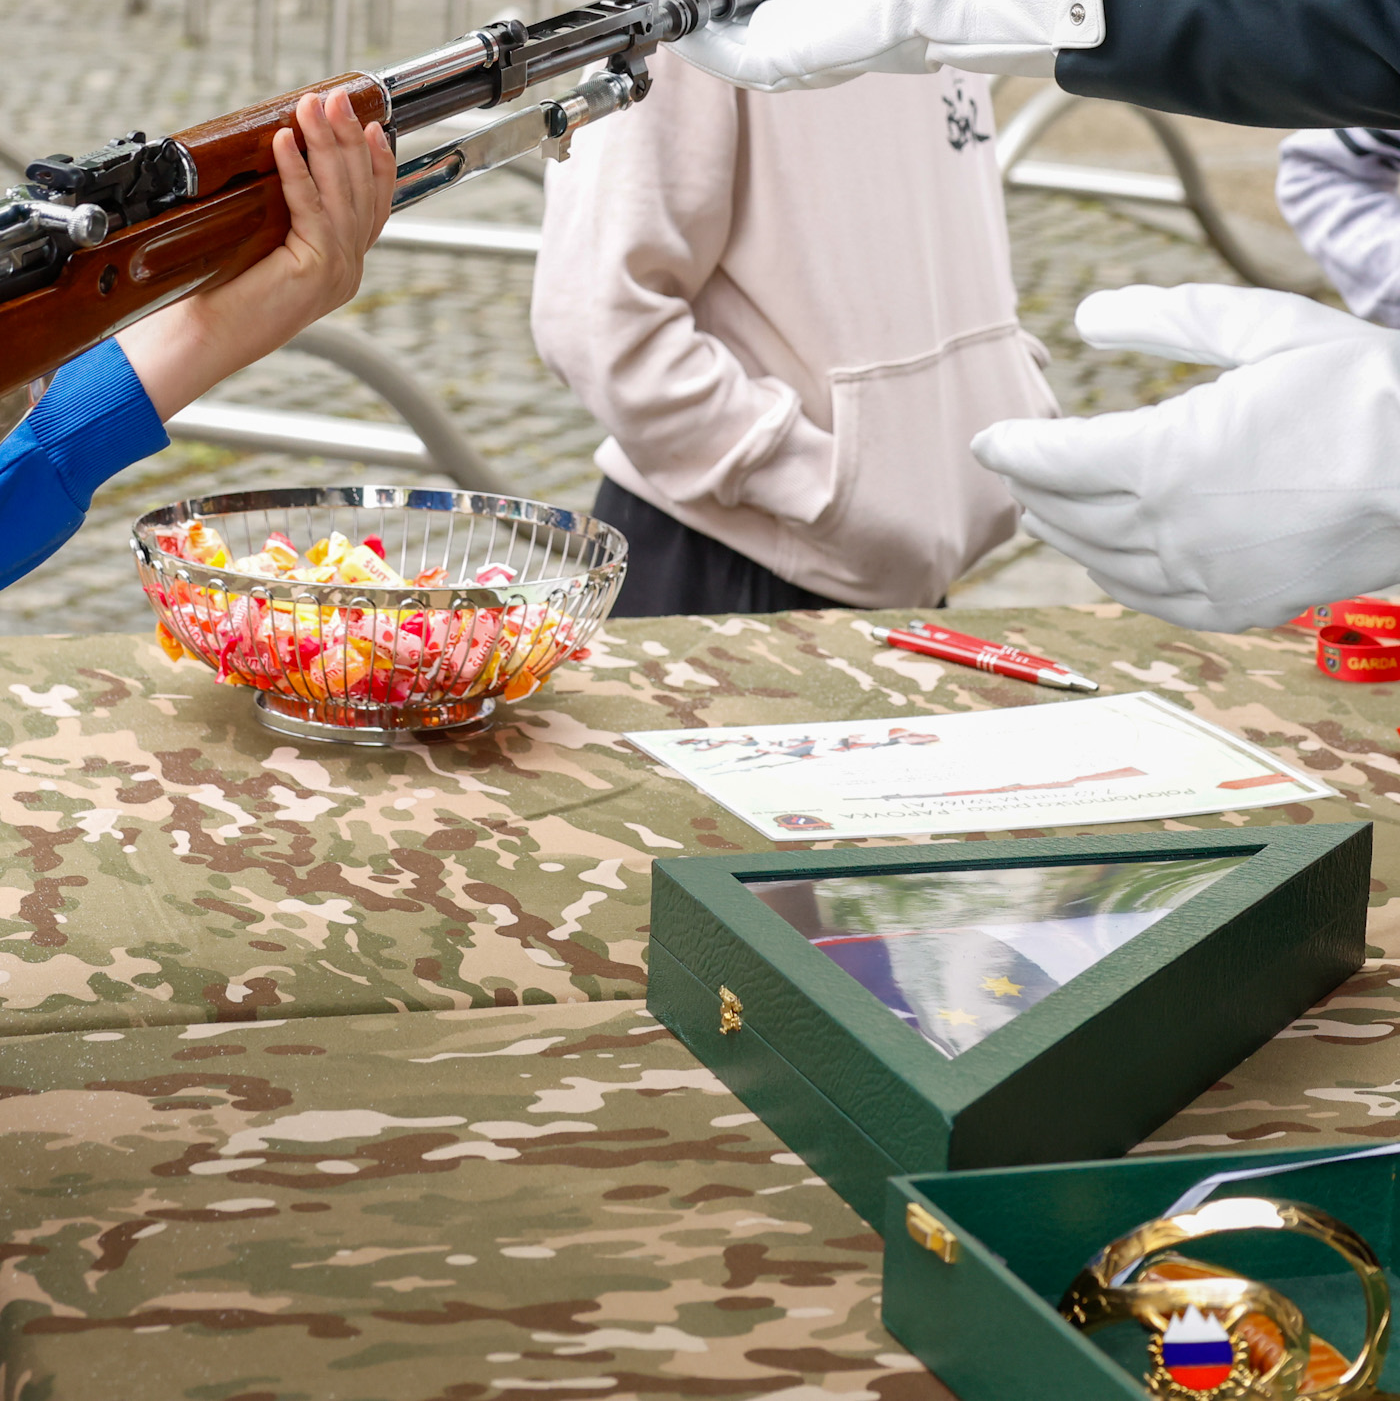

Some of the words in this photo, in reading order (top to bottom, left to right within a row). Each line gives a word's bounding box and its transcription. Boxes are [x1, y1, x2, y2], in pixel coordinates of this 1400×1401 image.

[1344, 612, 1397, 630] GARDA
[1347, 656, 1398, 671] GARDA
[838, 810, 951, 821] PAPOVKA
